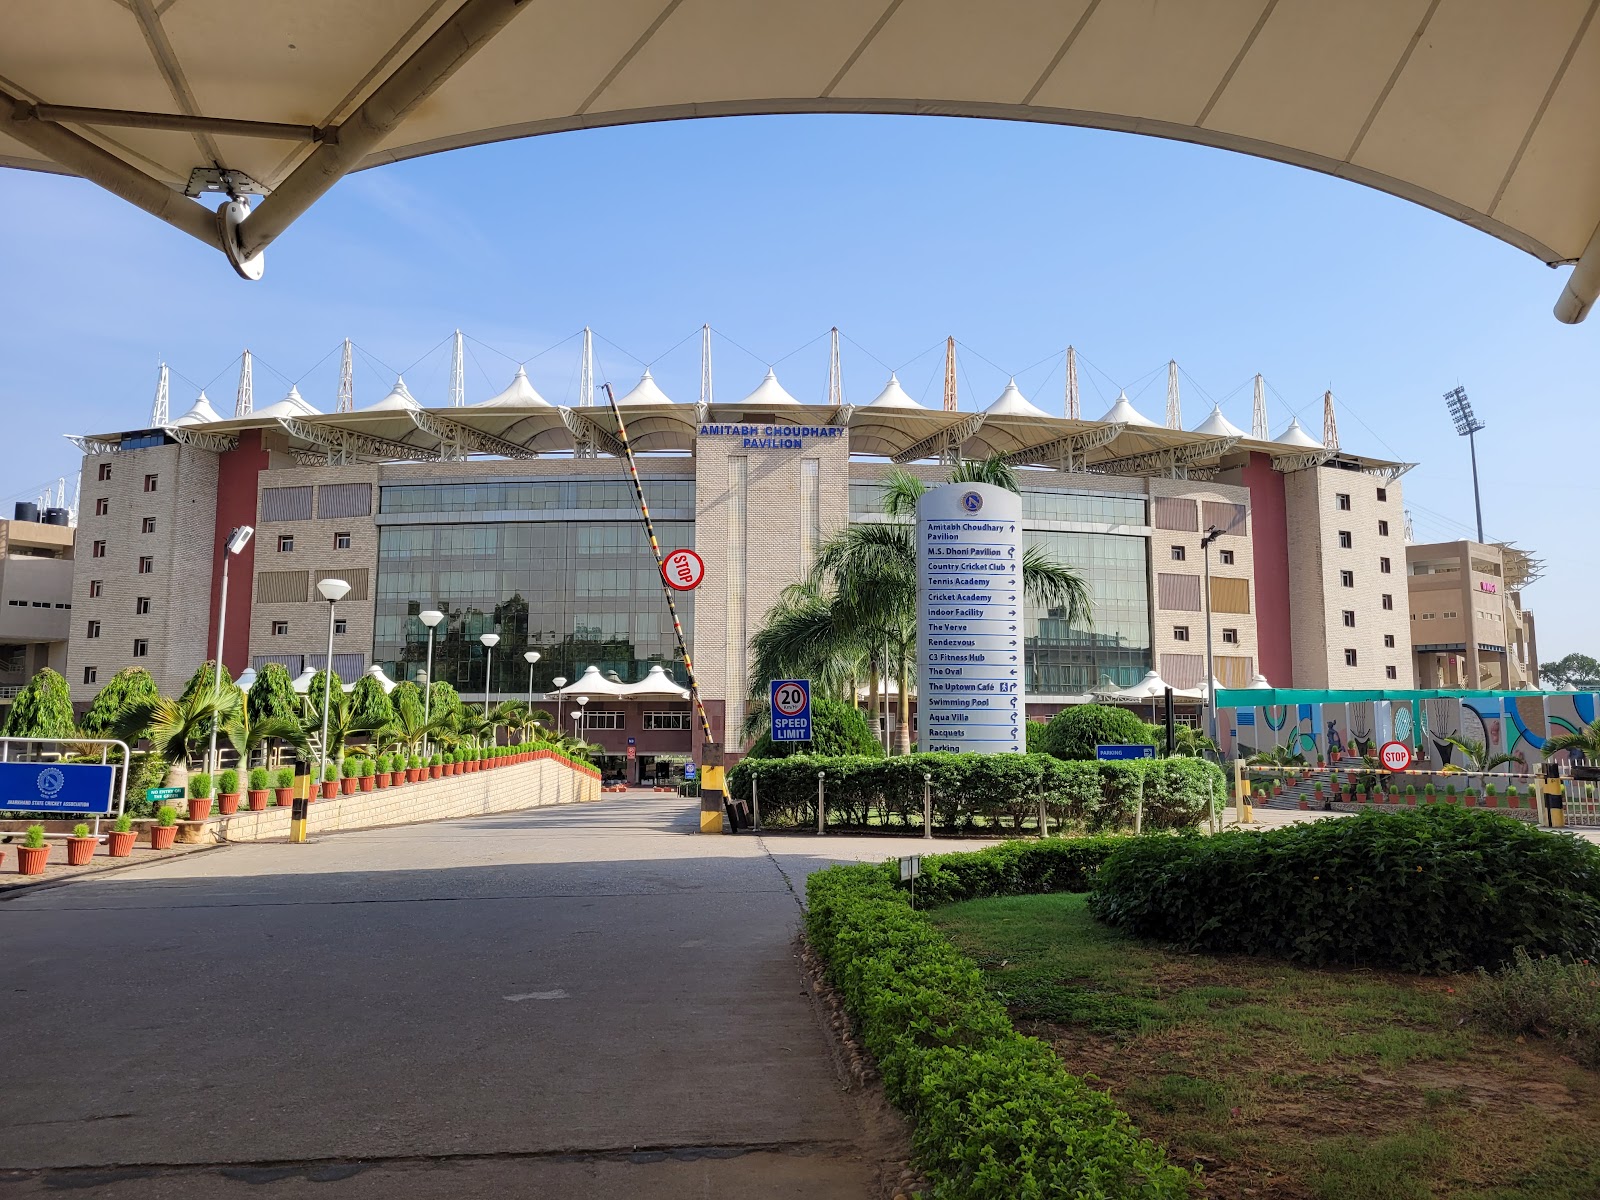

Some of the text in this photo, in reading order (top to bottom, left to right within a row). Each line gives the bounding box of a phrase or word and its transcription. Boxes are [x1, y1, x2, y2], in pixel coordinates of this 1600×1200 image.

[700, 425, 845, 437] AMITABH CHOUDHARY
[743, 438, 802, 448] PAVILION
[963, 524, 1003, 533] Choudhary
[673, 555, 693, 583] STOP
[928, 563, 959, 571] Country
[955, 578, 990, 587] Academy
[956, 594, 991, 602] Academy
[955, 609, 983, 617] Facility
[945, 683, 975, 692] Uptown
[781, 689, 801, 704] 20
[929, 699, 970, 708] Swimming
[929, 714, 949, 722] Aqua
[775, 718, 808, 728] SPEED
[777, 729, 806, 739] LIMIT
[929, 729, 964, 738] Racquets
[930, 745, 959, 753] Parking
[1385, 752, 1406, 762] STOP
